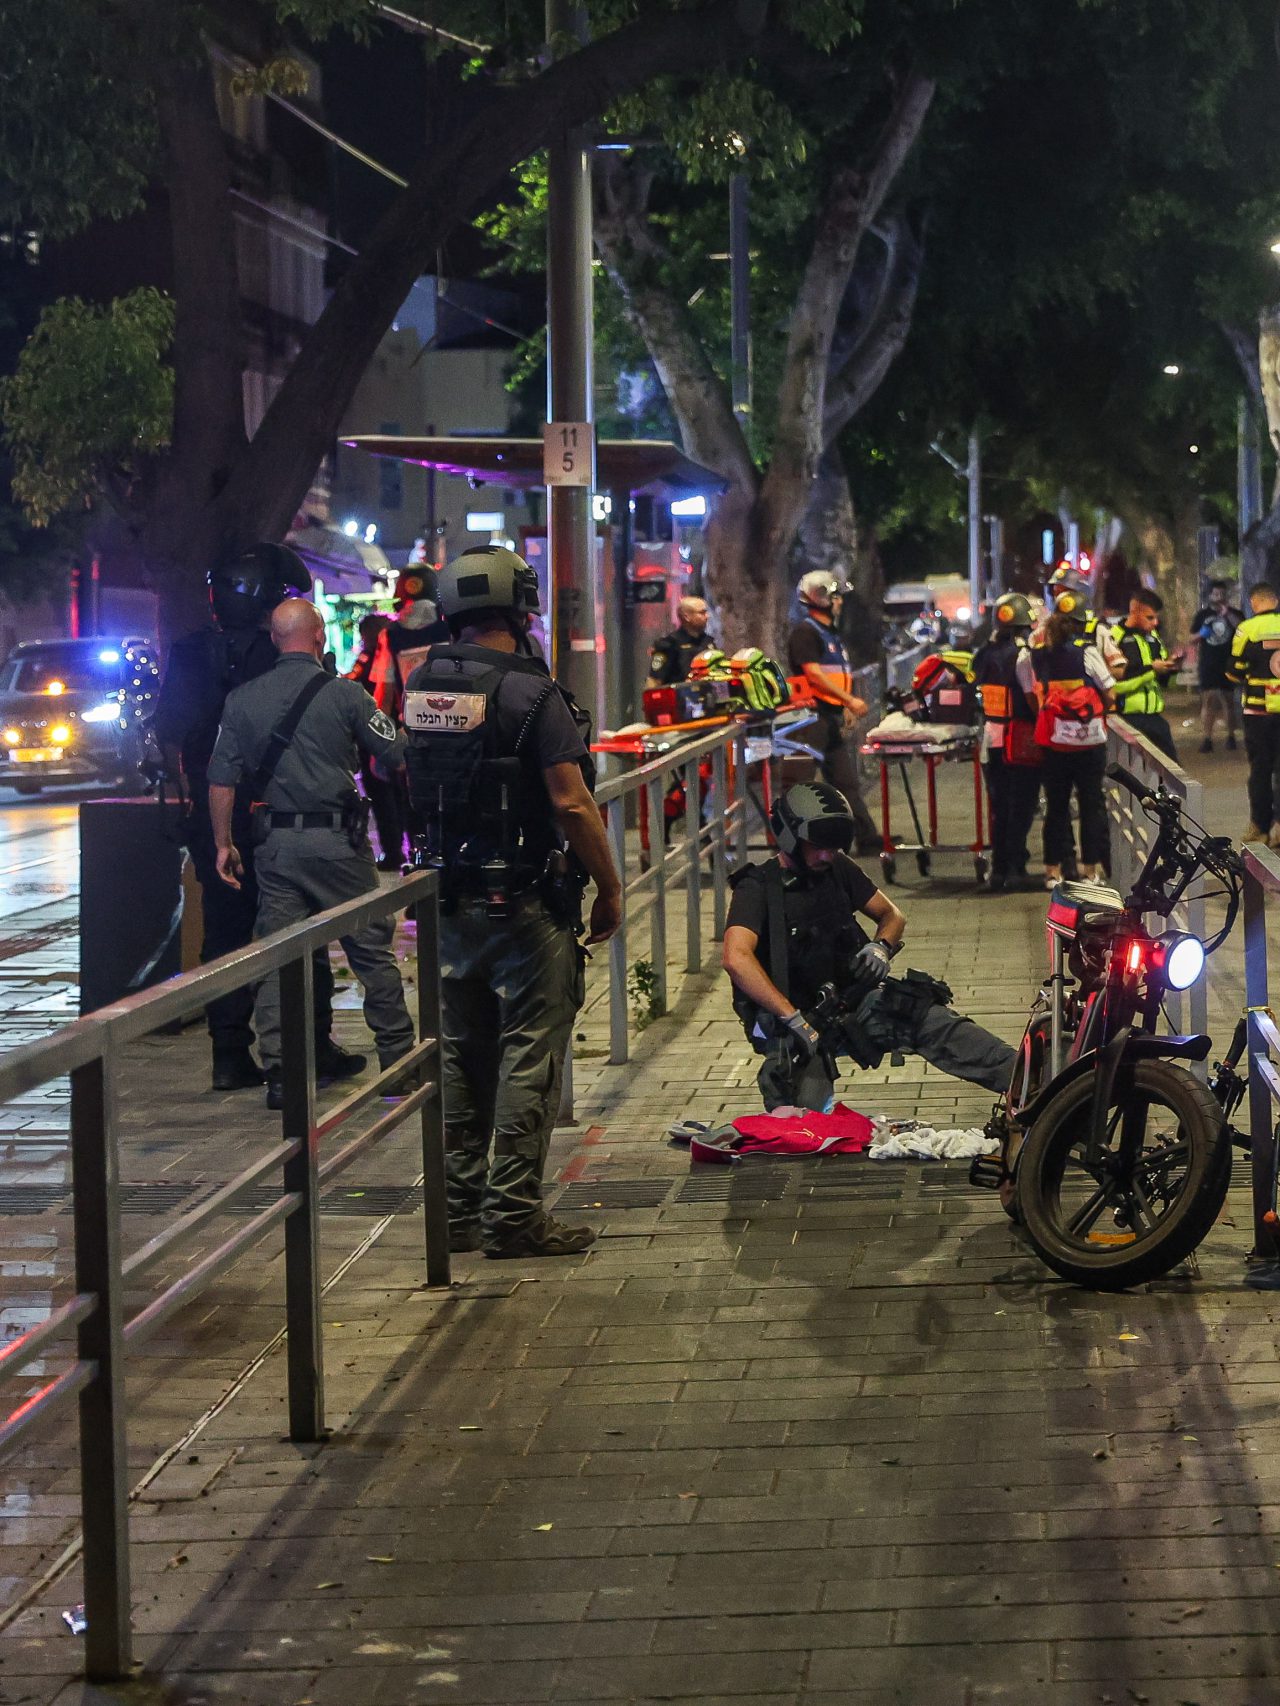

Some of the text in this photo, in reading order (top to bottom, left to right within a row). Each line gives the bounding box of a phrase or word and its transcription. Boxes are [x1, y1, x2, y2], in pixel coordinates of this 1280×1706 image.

[561, 428, 577, 447] 11
[562, 452, 574, 472] 5
[416, 712, 468, 727] קצין חבלה
